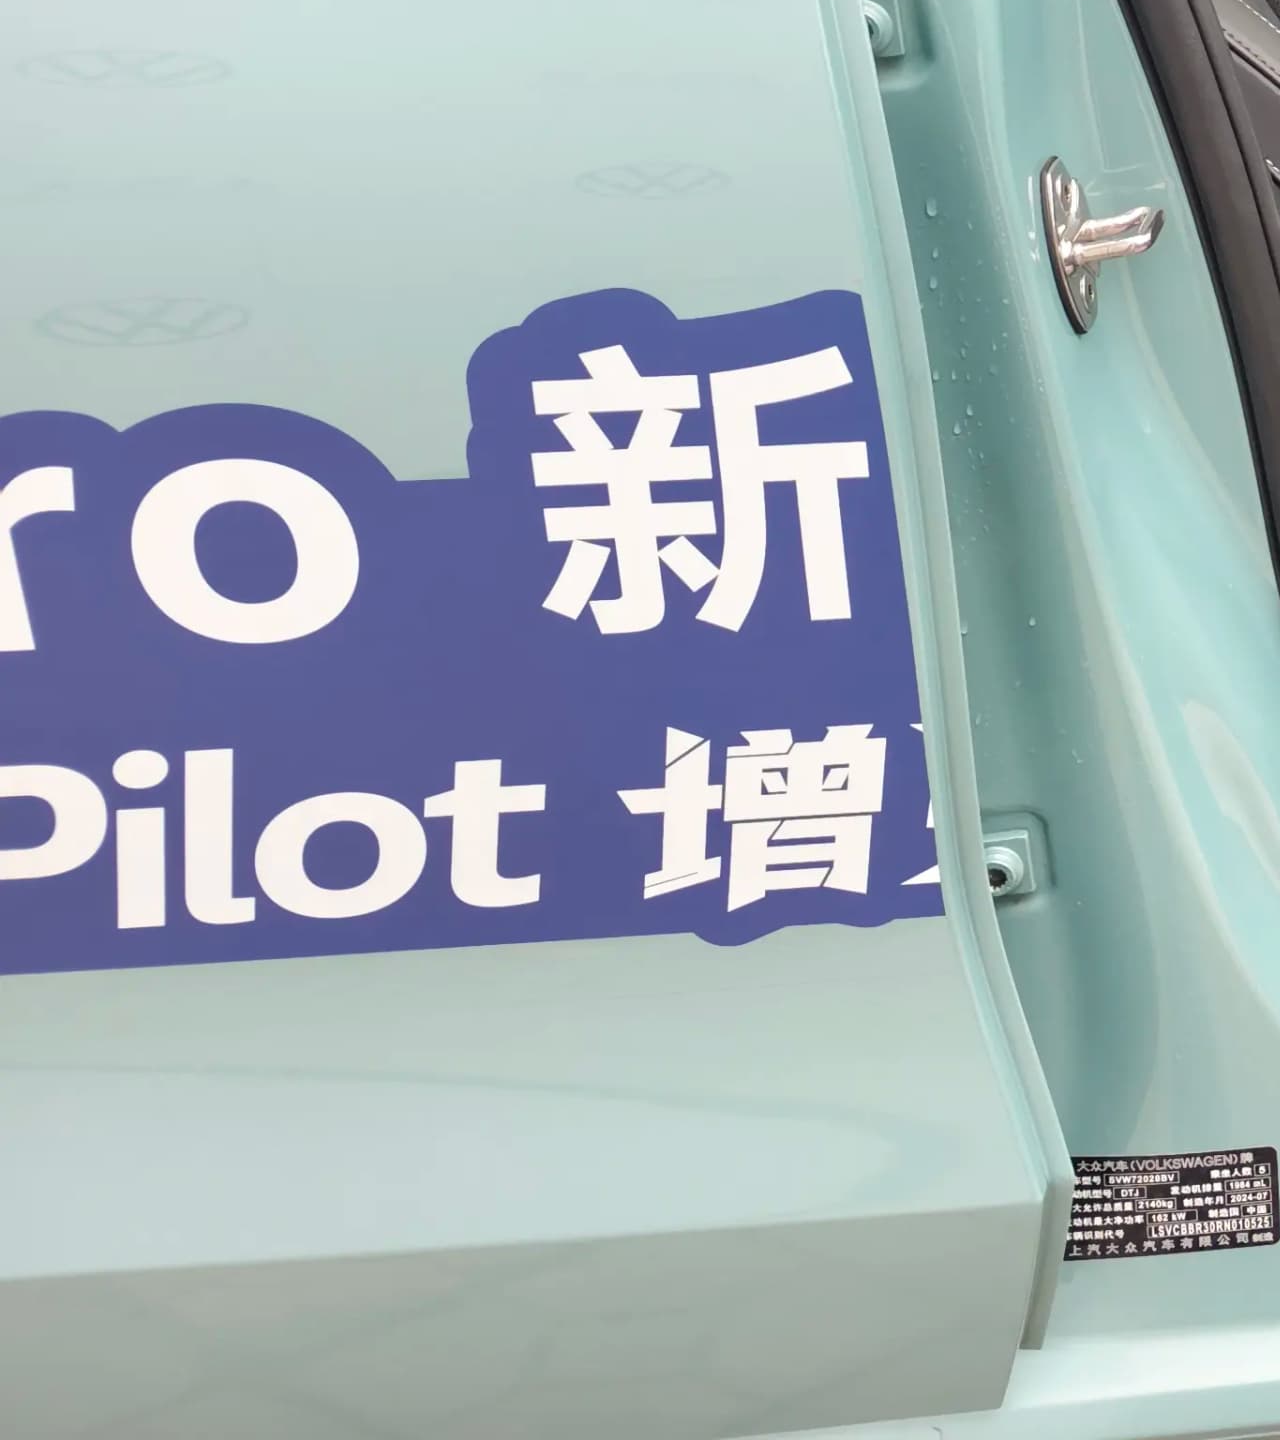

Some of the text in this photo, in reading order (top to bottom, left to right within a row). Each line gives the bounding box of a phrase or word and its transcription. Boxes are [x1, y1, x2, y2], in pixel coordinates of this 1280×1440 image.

[531, 344, 870, 635] 新
[616, 722, 942, 912] 增
[1120, 1188, 1140, 1198] DTJ
[1230, 1192, 1268, 1203] 2024-07
[1137, 1199, 1174, 1211] 2140kg
[1246, 1204, 1268, 1216] 中国
[1070, 1214, 1145, 1228] 动机最大净功率
[1151, 1217, 1271, 1239] LSVCBBR30RN010525
